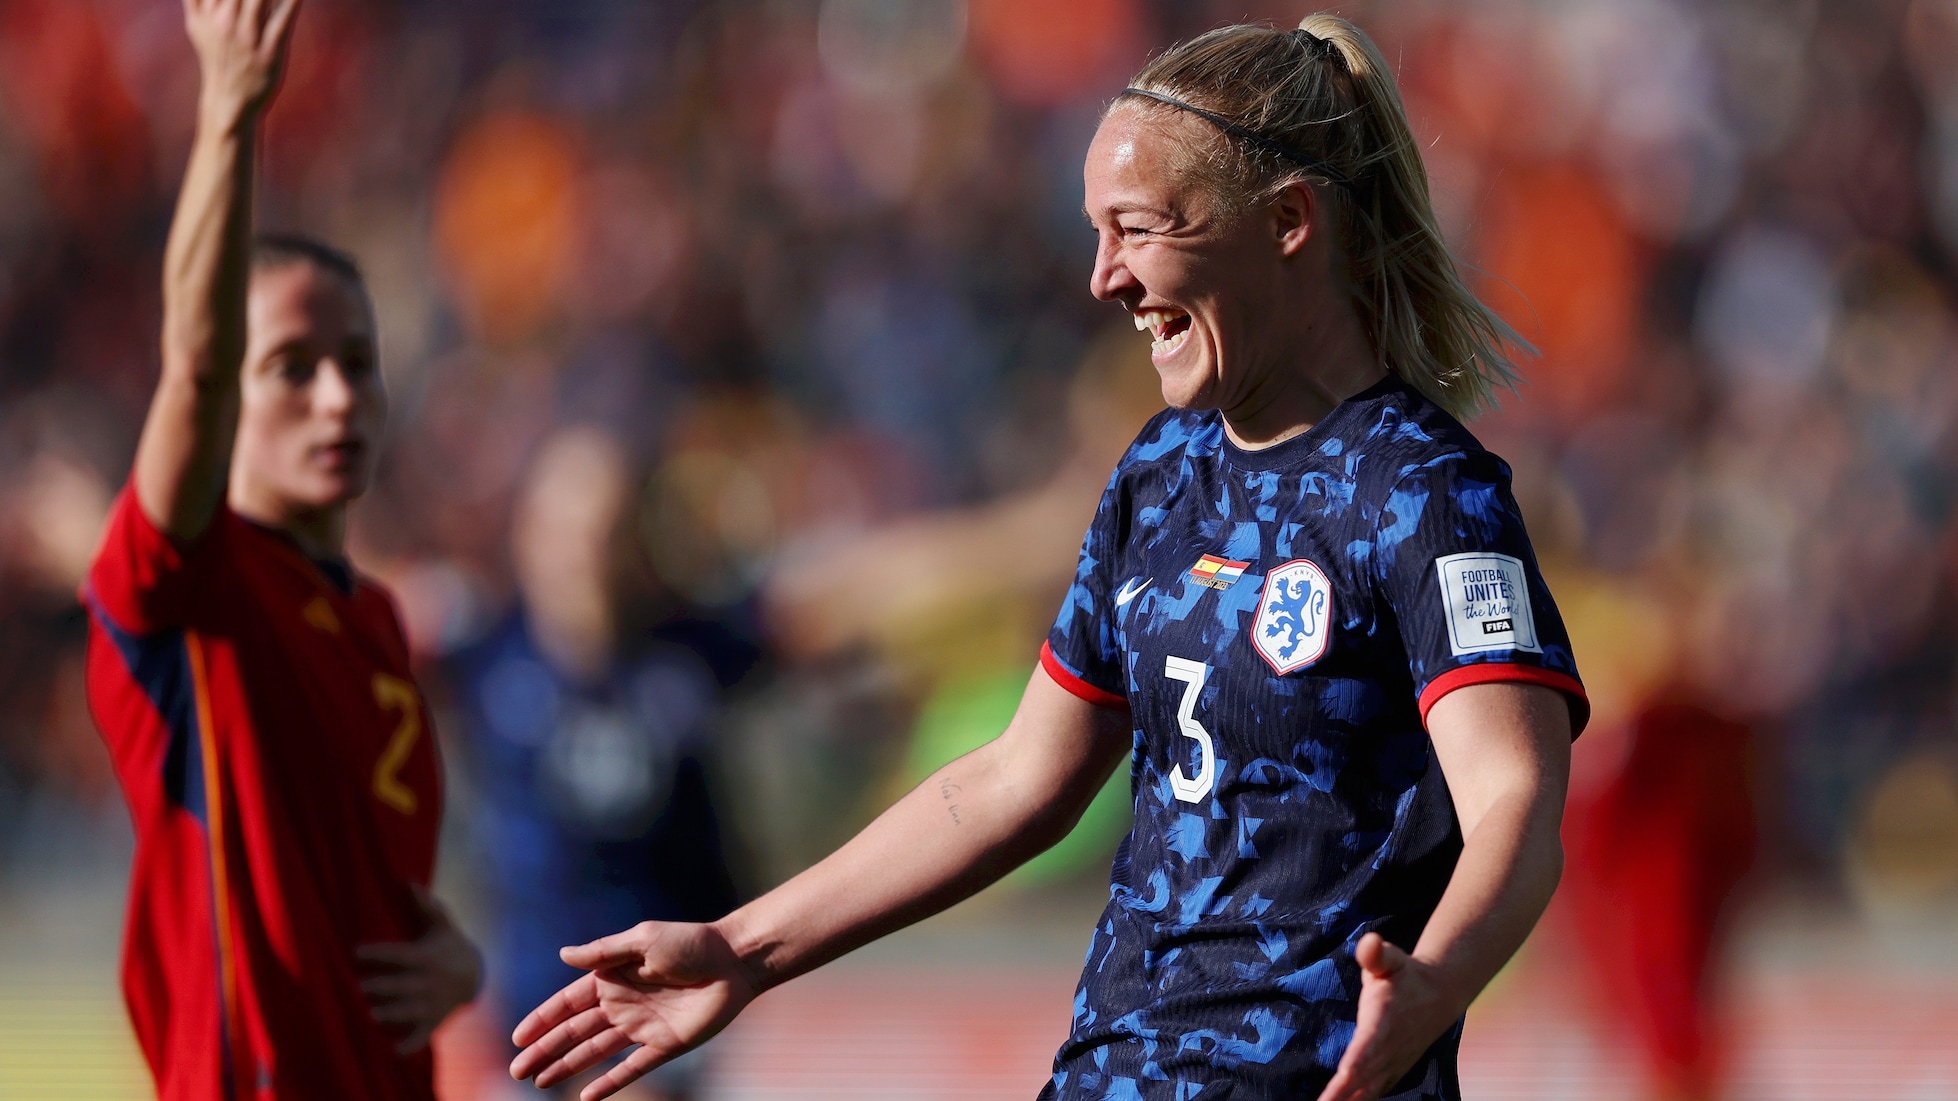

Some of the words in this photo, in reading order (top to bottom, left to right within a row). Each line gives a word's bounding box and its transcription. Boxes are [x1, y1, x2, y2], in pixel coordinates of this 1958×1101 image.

[1461, 569, 1513, 584] FOOTBALL
[1464, 582, 1516, 602] UNITES
[1463, 603, 1485, 619] the
[1487, 601, 1519, 616] World
[1486, 620, 1510, 632] FIFA
[1165, 655, 1215, 804] 3
[371, 671, 421, 816] 2
